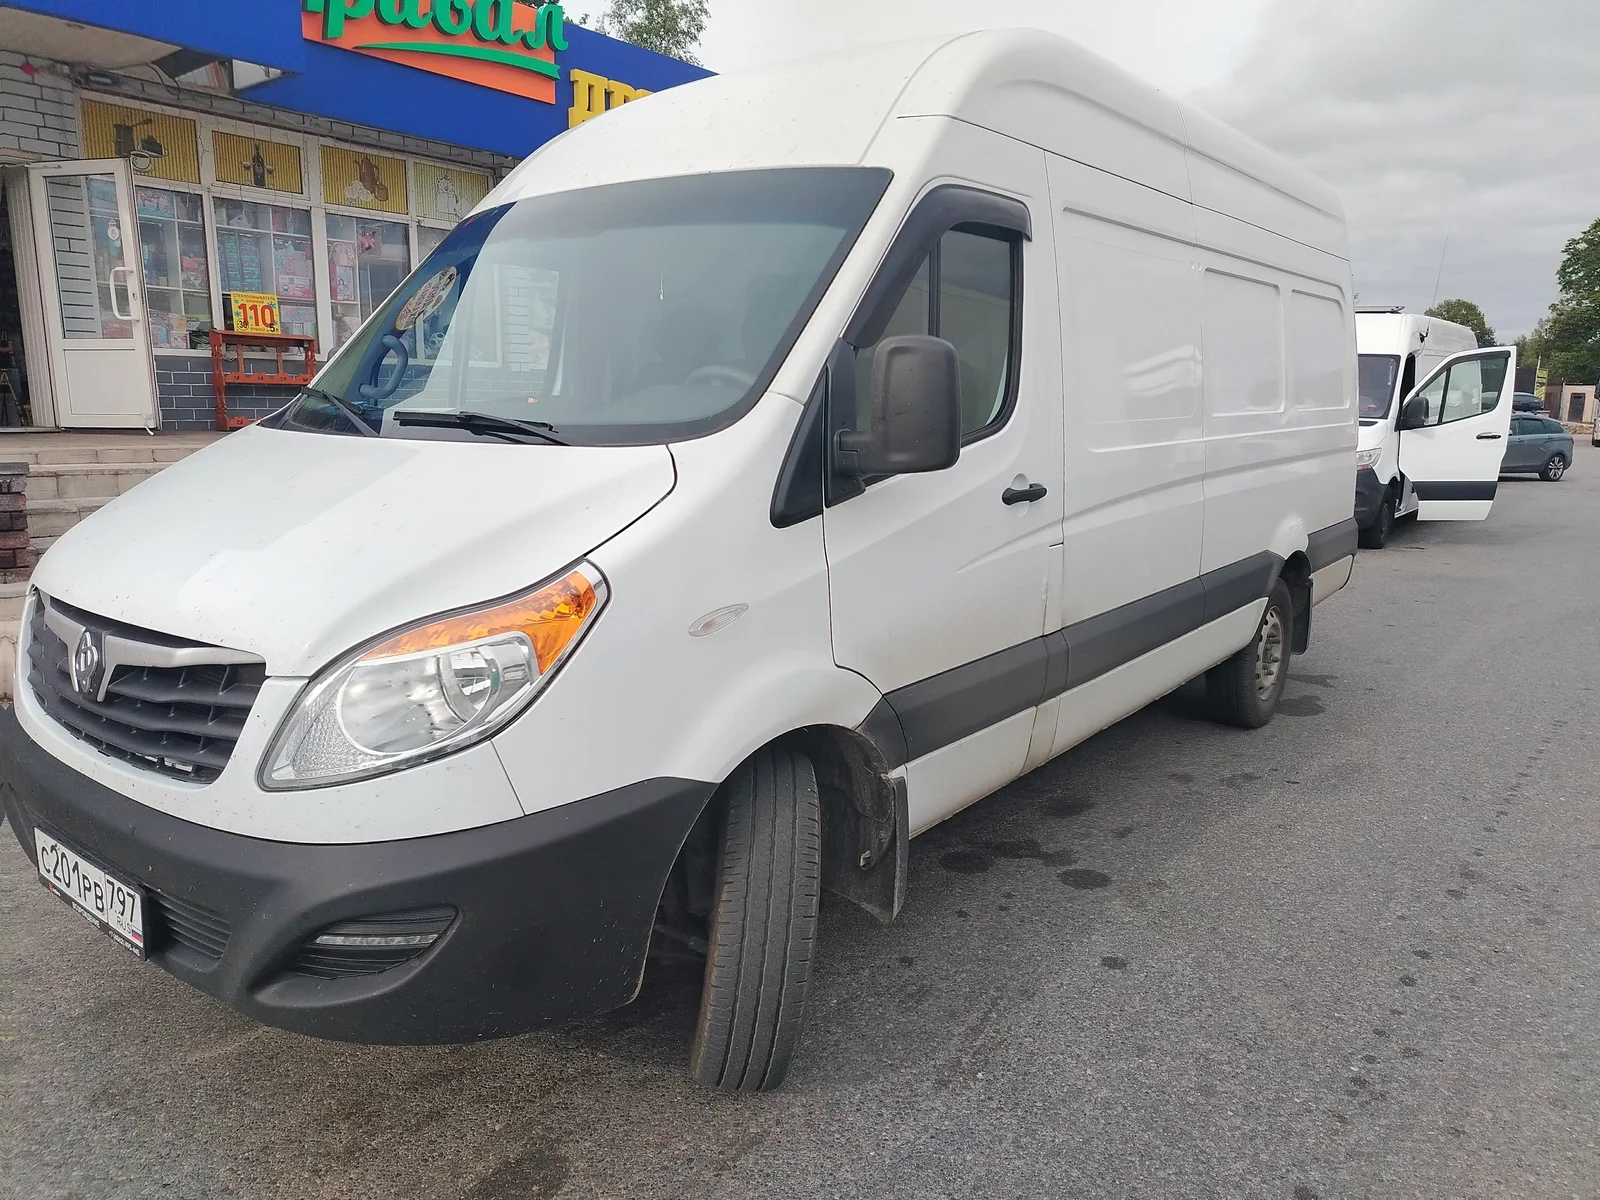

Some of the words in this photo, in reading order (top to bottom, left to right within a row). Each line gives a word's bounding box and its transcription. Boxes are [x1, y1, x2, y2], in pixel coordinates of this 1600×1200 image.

[299, 0, 569, 51] ривал
[237, 303, 275, 328] 110
[107, 879, 136, 923] 797
[116, 915, 132, 934] RUS
